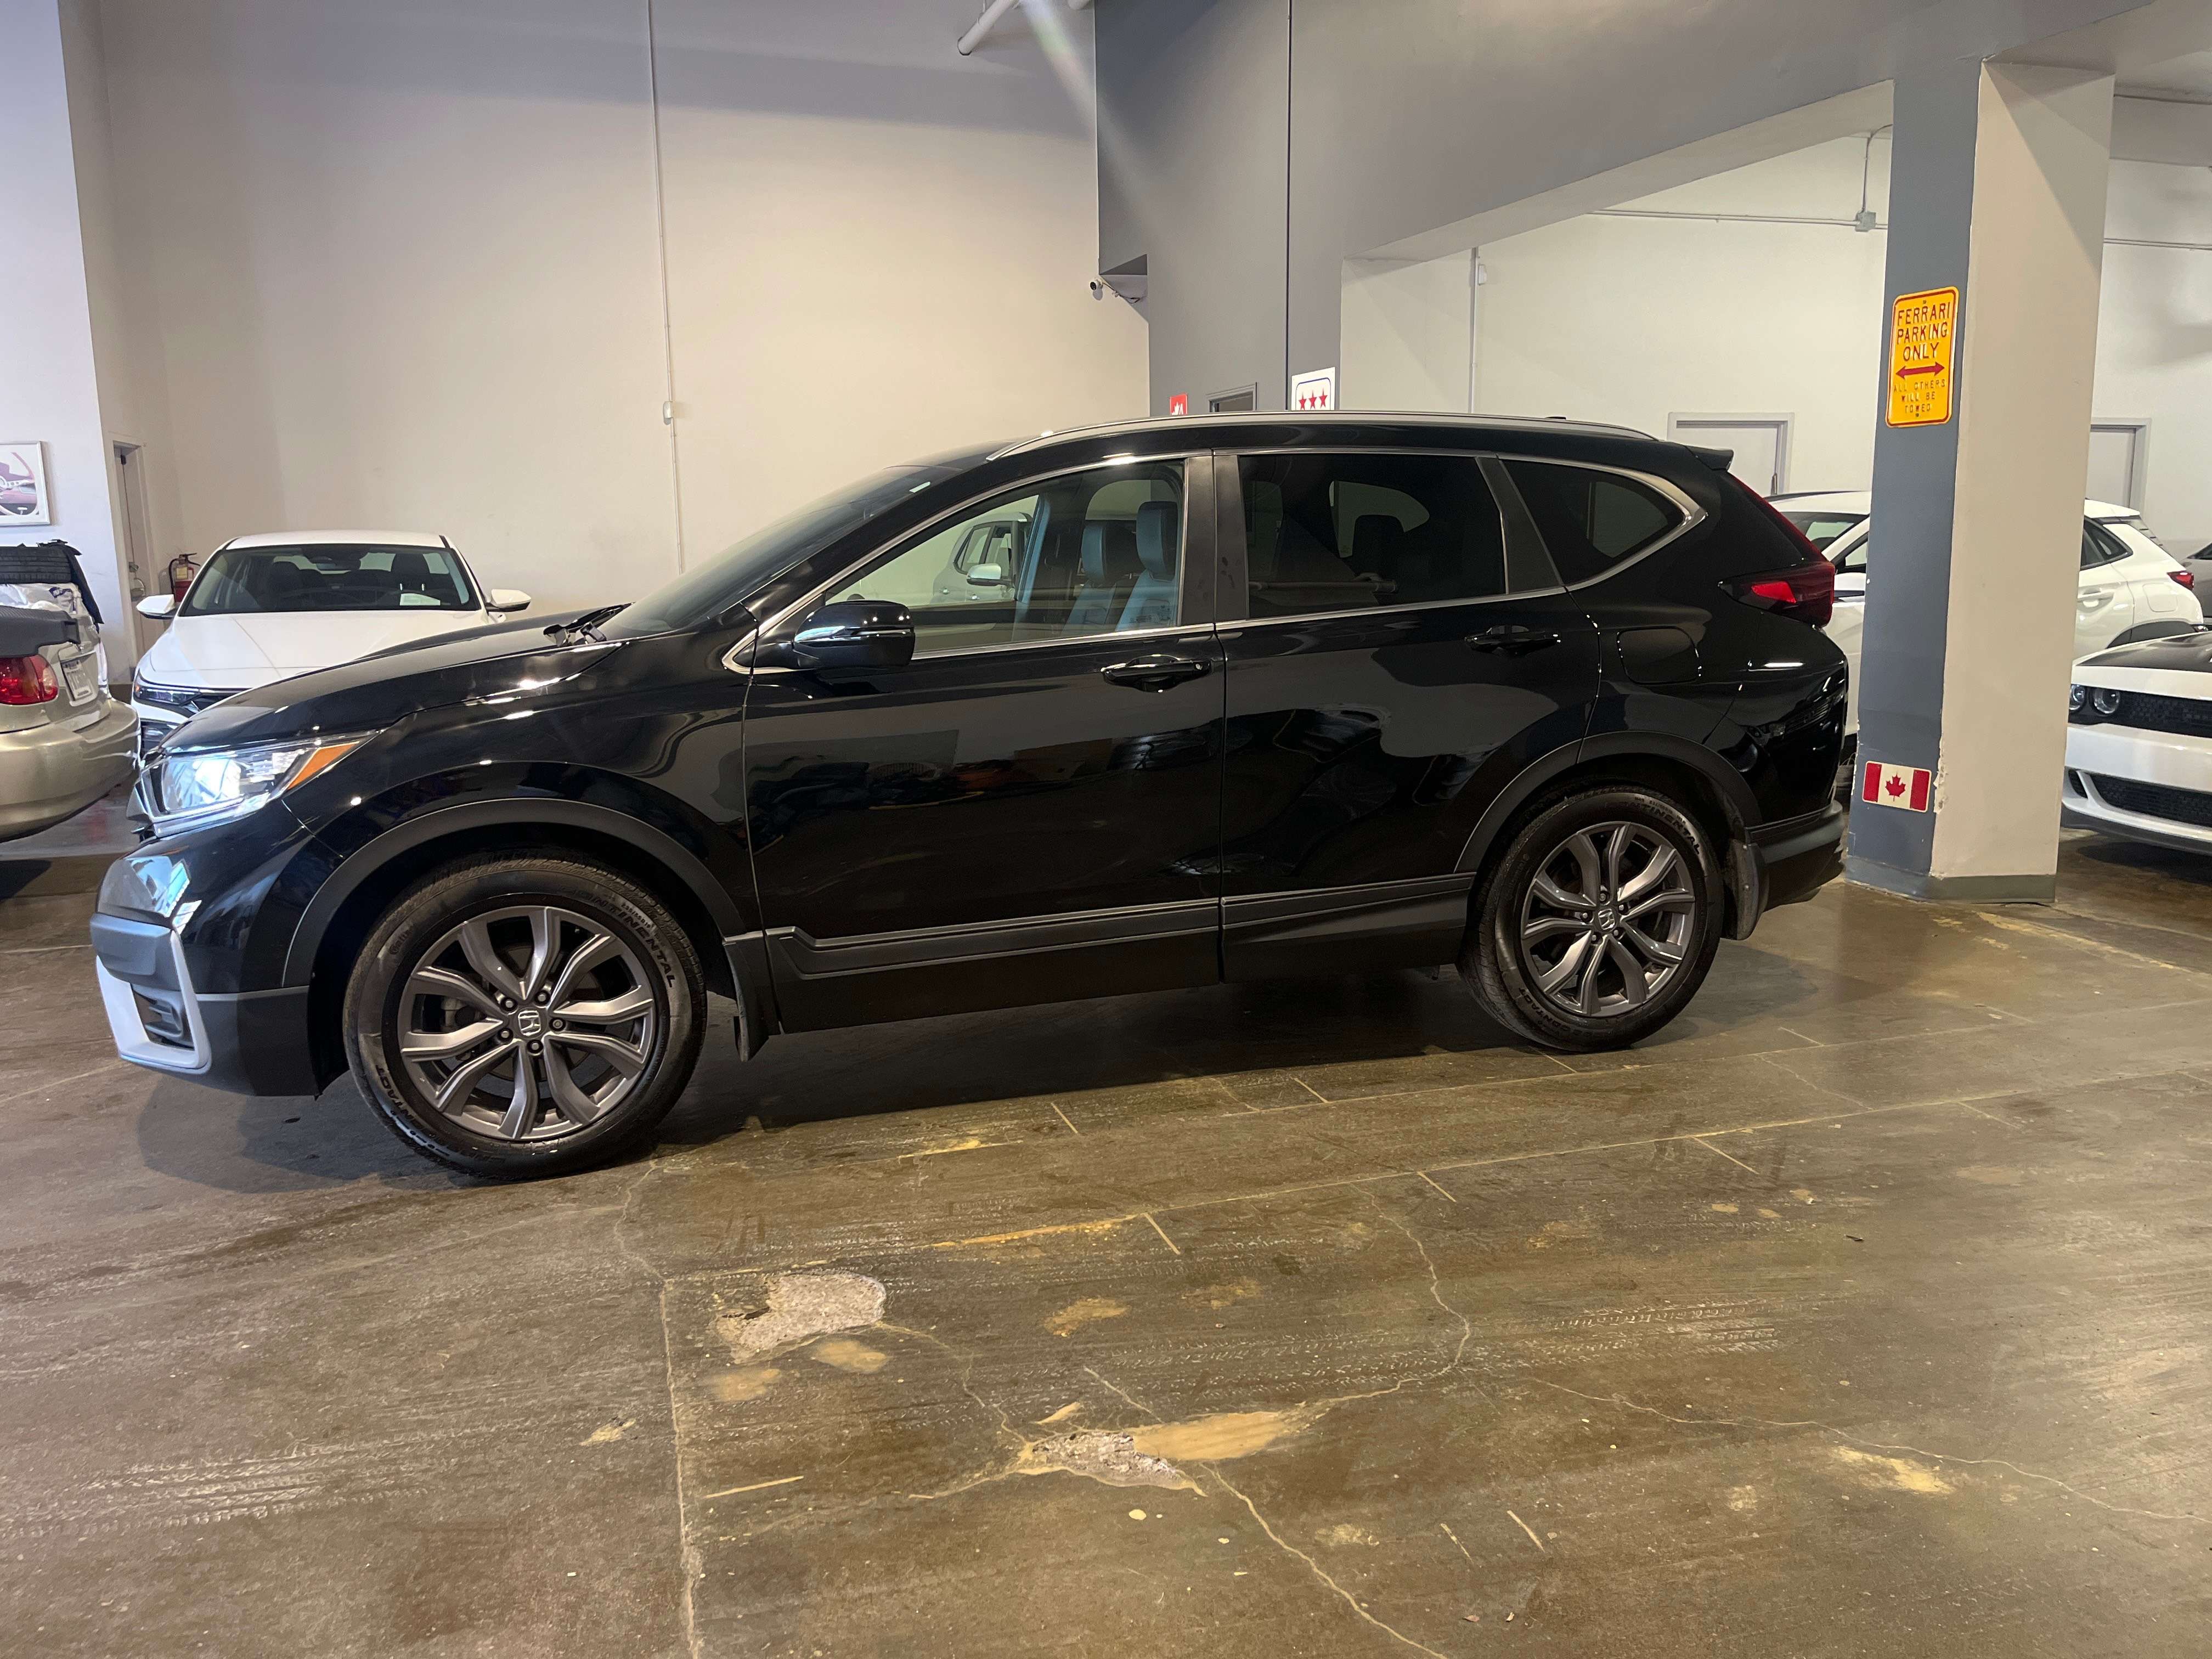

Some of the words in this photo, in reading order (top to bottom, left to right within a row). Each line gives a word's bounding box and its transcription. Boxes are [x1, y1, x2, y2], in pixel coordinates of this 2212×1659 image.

[1897, 302, 1951, 326] FERRARI
[1897, 321, 1948, 345] PARKING
[1903, 342, 1939, 362] ONLY
[1893, 384, 1907, 392] ALL
[1914, 379, 1945, 391] OTHERS
[1901, 393, 1919, 402] WILL
[1926, 391, 1936, 400] BE
[1905, 403, 1931, 413] TOWED
[1606, 801, 1700, 855] NTINENTAL
